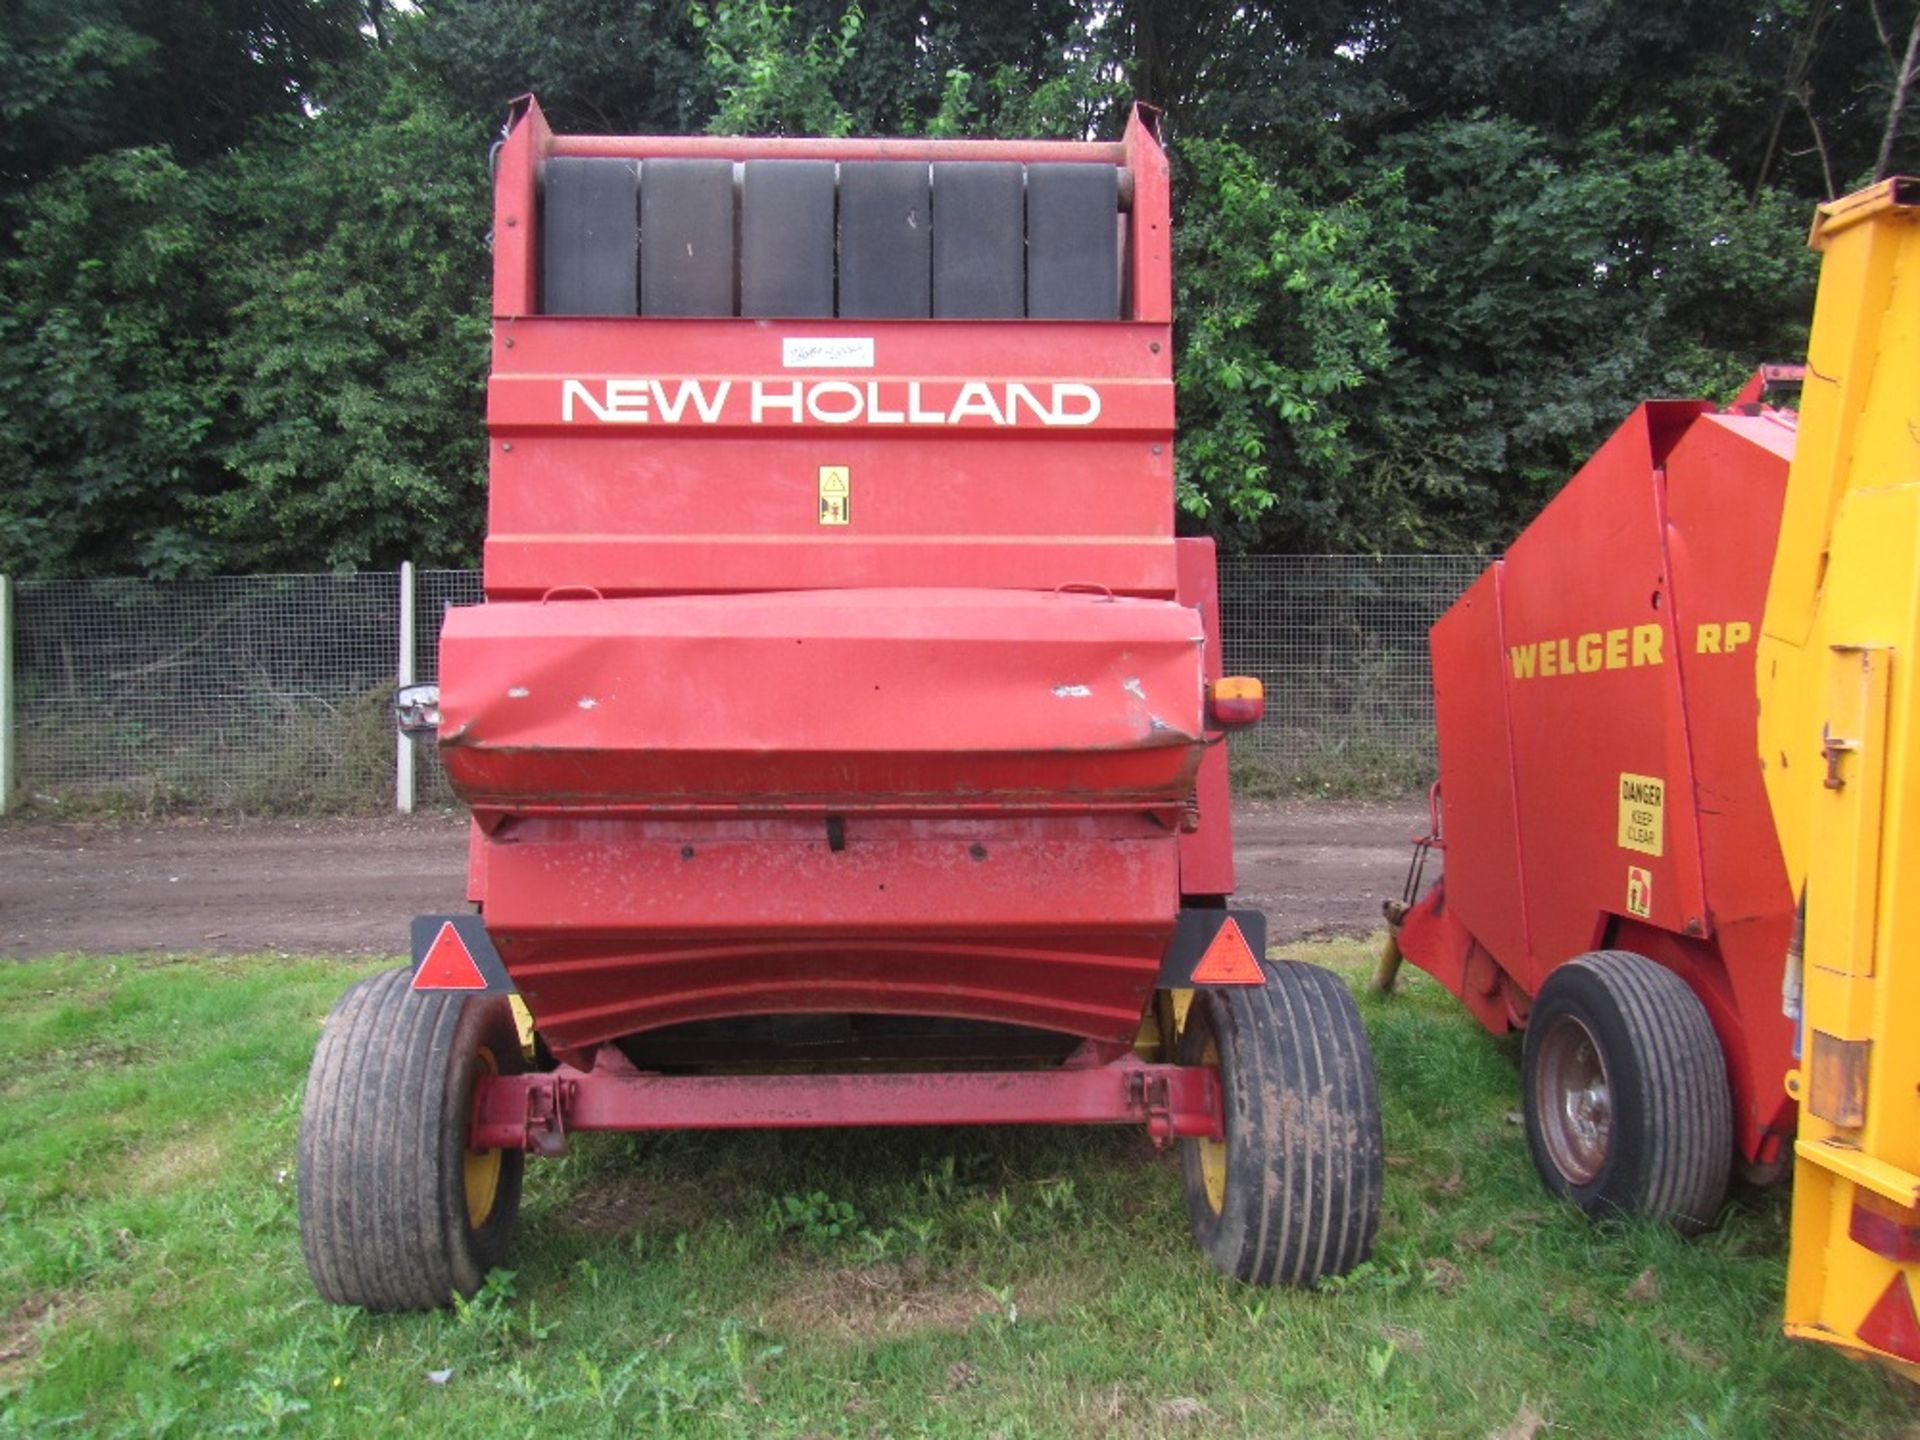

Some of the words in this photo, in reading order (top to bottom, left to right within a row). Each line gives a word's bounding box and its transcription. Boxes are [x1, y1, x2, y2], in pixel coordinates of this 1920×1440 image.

[562, 380, 732, 423] NEW
[751, 381, 1102, 425] HOLLAND
[1510, 623, 1664, 679] WELGER
[1697, 622, 1751, 654] RP
[1623, 780, 1662, 807] DANGER
[1631, 810, 1654, 827] KEEP
[1627, 826, 1655, 845] CLEAR
